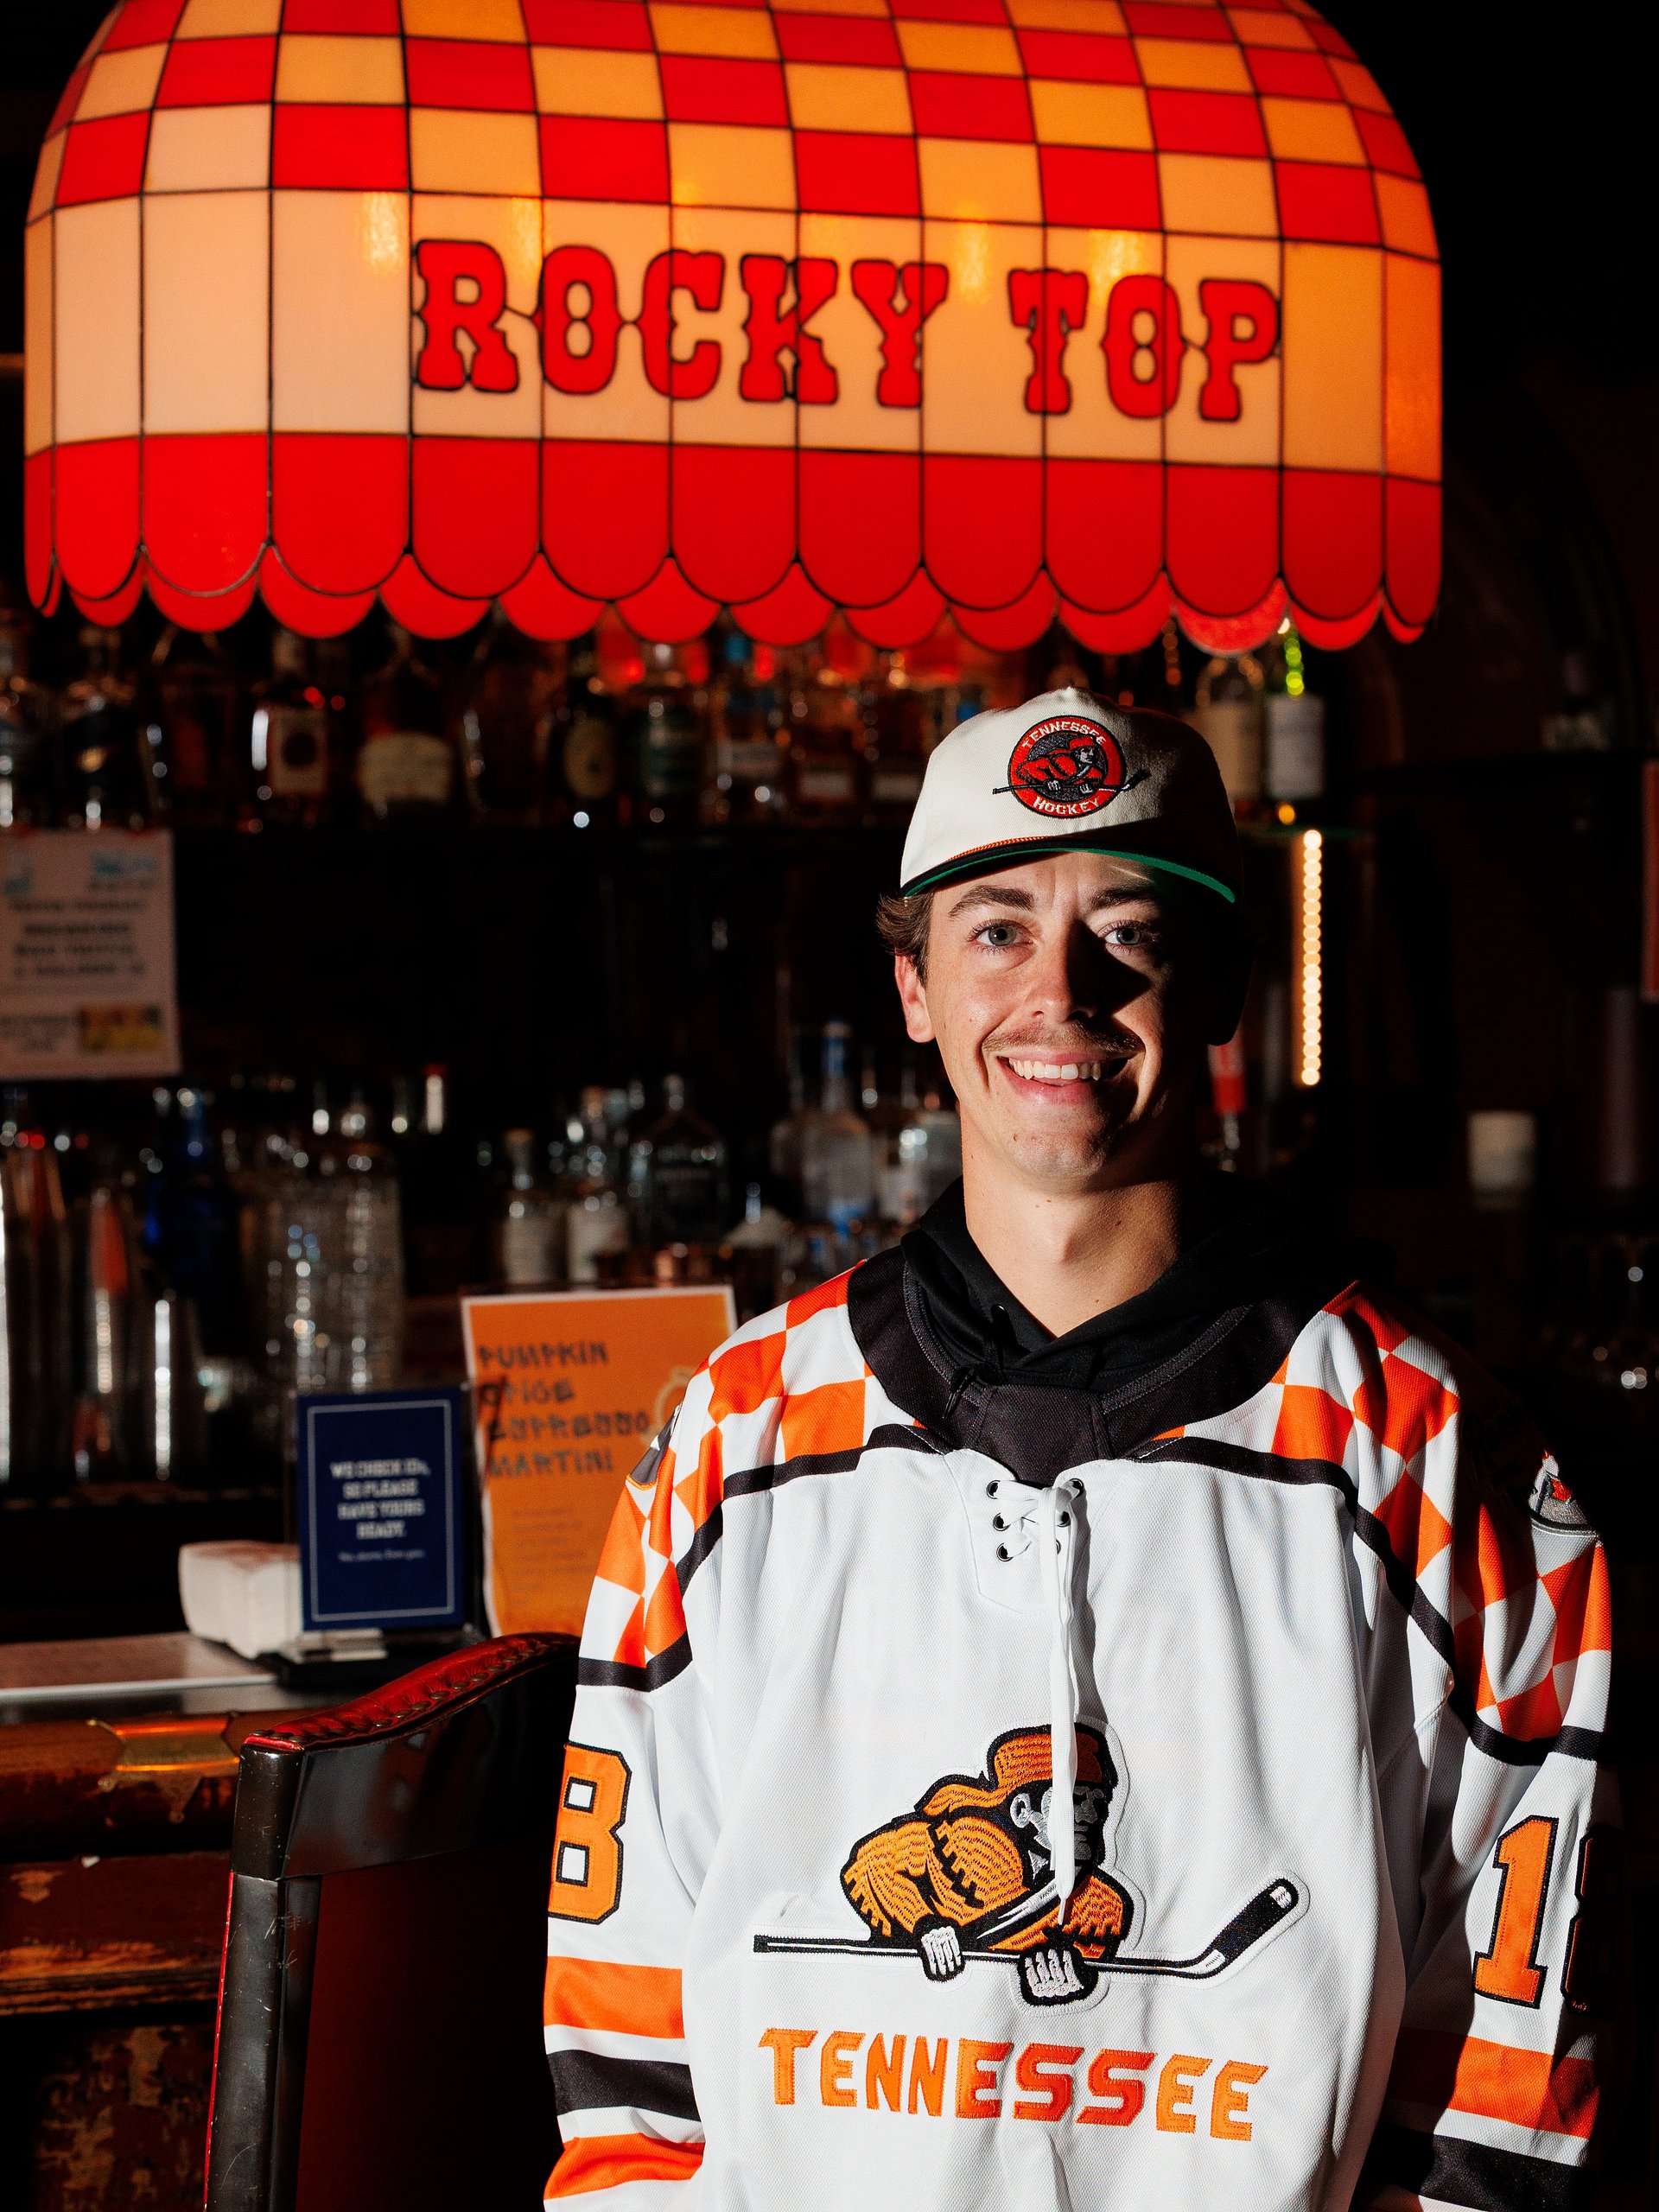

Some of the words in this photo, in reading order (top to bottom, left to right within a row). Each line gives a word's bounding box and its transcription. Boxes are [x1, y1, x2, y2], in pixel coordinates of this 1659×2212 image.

[414, 238, 949, 408] ROCKY
[1007, 267, 1282, 421] TOP
[1021, 721, 1107, 749] TENNESSEE
[1033, 796, 1101, 815] HOCKEY
[478, 1341, 609, 1370] PUMPKIN
[487, 1447, 614, 1479] MARTINI
[758, 2027, 1268, 2142] TENNESSEE
